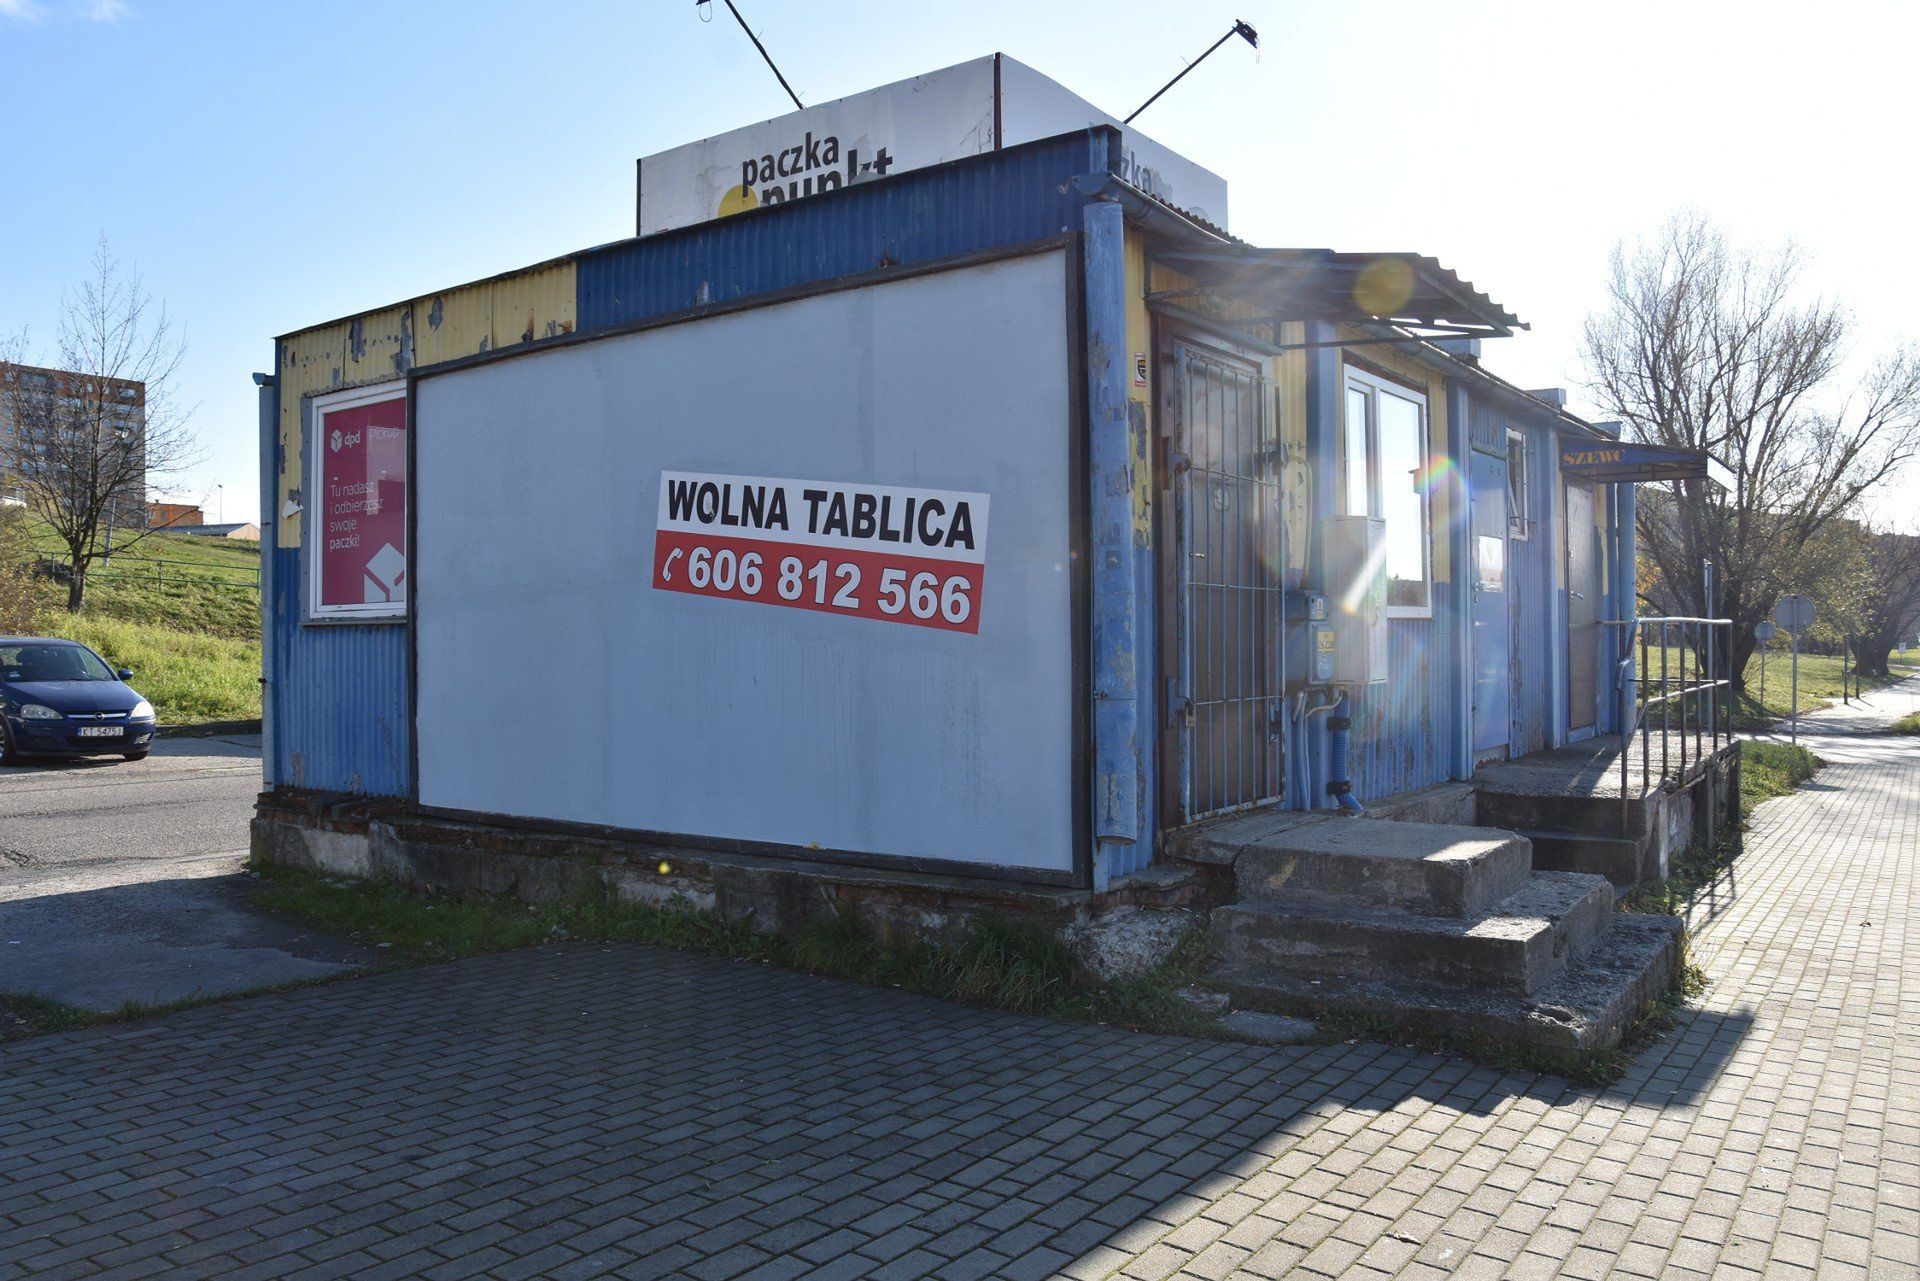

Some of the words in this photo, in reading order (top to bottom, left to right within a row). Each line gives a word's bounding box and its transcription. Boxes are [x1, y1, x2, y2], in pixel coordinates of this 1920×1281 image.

[742, 132, 839, 198] paczka
[344, 430, 361, 447] dpd
[1563, 448, 1626, 465] SZEWC
[331, 485, 341, 496] Tu
[343, 481, 374, 495] nadasz
[668, 480, 789, 531] WOLNA
[803, 489, 975, 550] TABLICA
[330, 519, 357, 533] swoje
[329, 533, 360, 552] paczki!
[688, 547, 764, 596] 606
[777, 556, 862, 609] 812
[877, 567, 971, 624] 566
